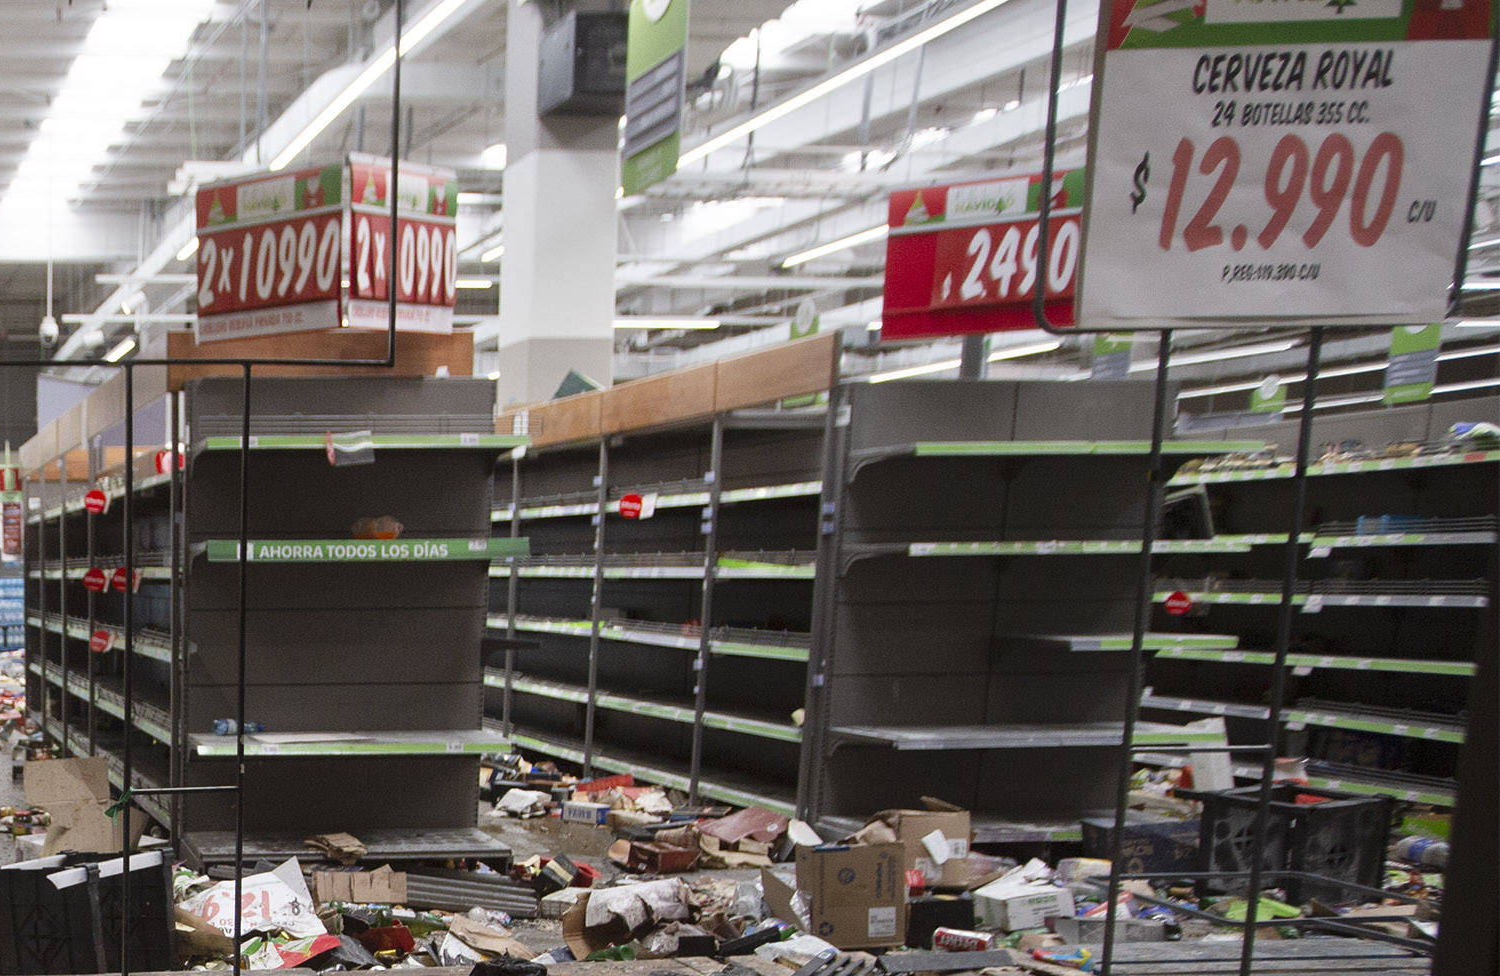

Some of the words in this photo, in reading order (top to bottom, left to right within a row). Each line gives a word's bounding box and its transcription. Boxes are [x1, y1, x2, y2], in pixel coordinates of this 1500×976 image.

[1193, 51, 1306, 94] CERVEZA
[1312, 49, 1394, 90] ROYAL
[1211, 101, 1234, 128] 24
[1241, 101, 1312, 127] BOTELLAS
[1315, 100, 1345, 126] 355
[1130, 151, 1150, 214] $
[1158, 132, 1404, 253] 12.990
[1407, 200, 1436, 223] C/U
[259, 545, 322, 559] AHORRA
[326, 544, 376, 559] TODOS
[381, 544, 409, 559] LOS
[413, 541, 449, 558] DÍAS
